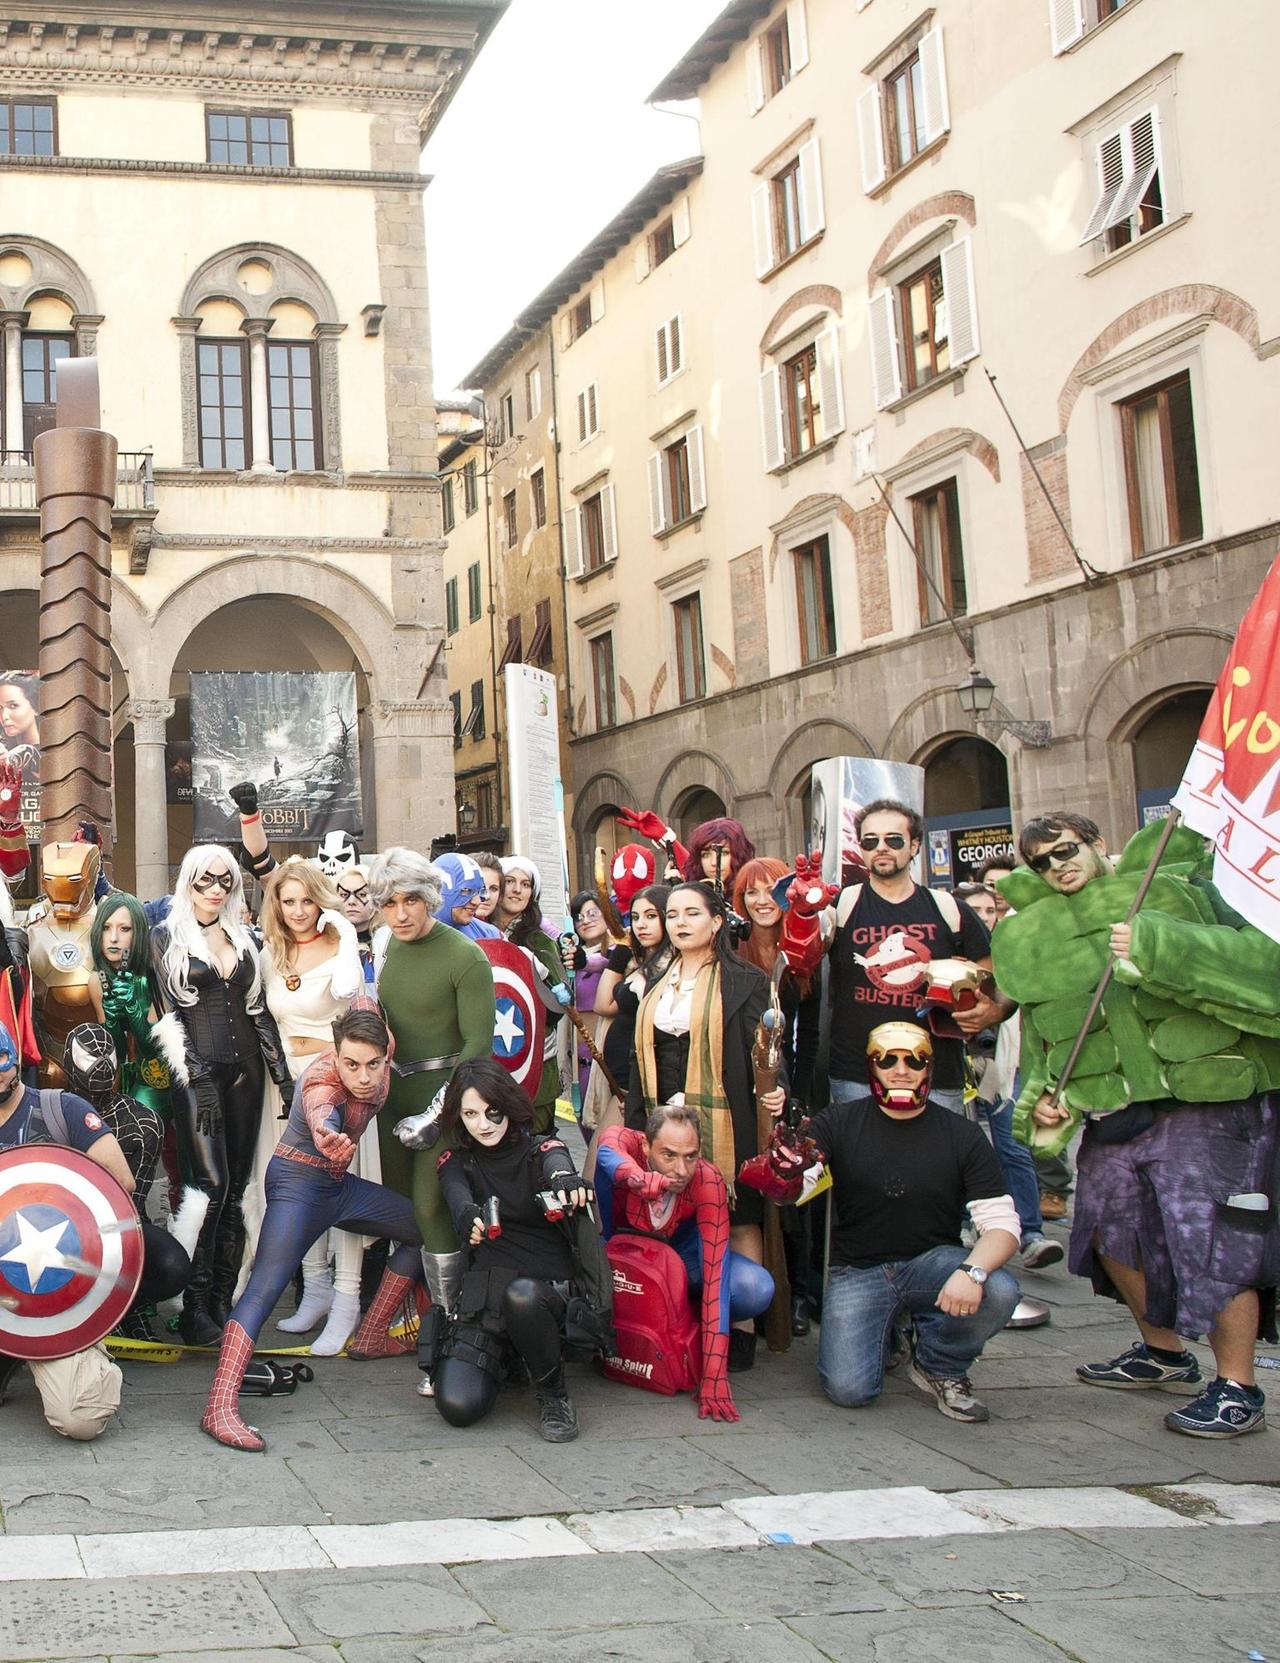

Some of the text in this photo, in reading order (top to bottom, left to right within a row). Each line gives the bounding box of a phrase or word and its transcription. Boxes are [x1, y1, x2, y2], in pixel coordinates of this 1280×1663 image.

[958, 843, 1015, 862] GEORGIA
[852, 923, 937, 945] GHOST
[854, 986, 924, 1008] BUSTER
